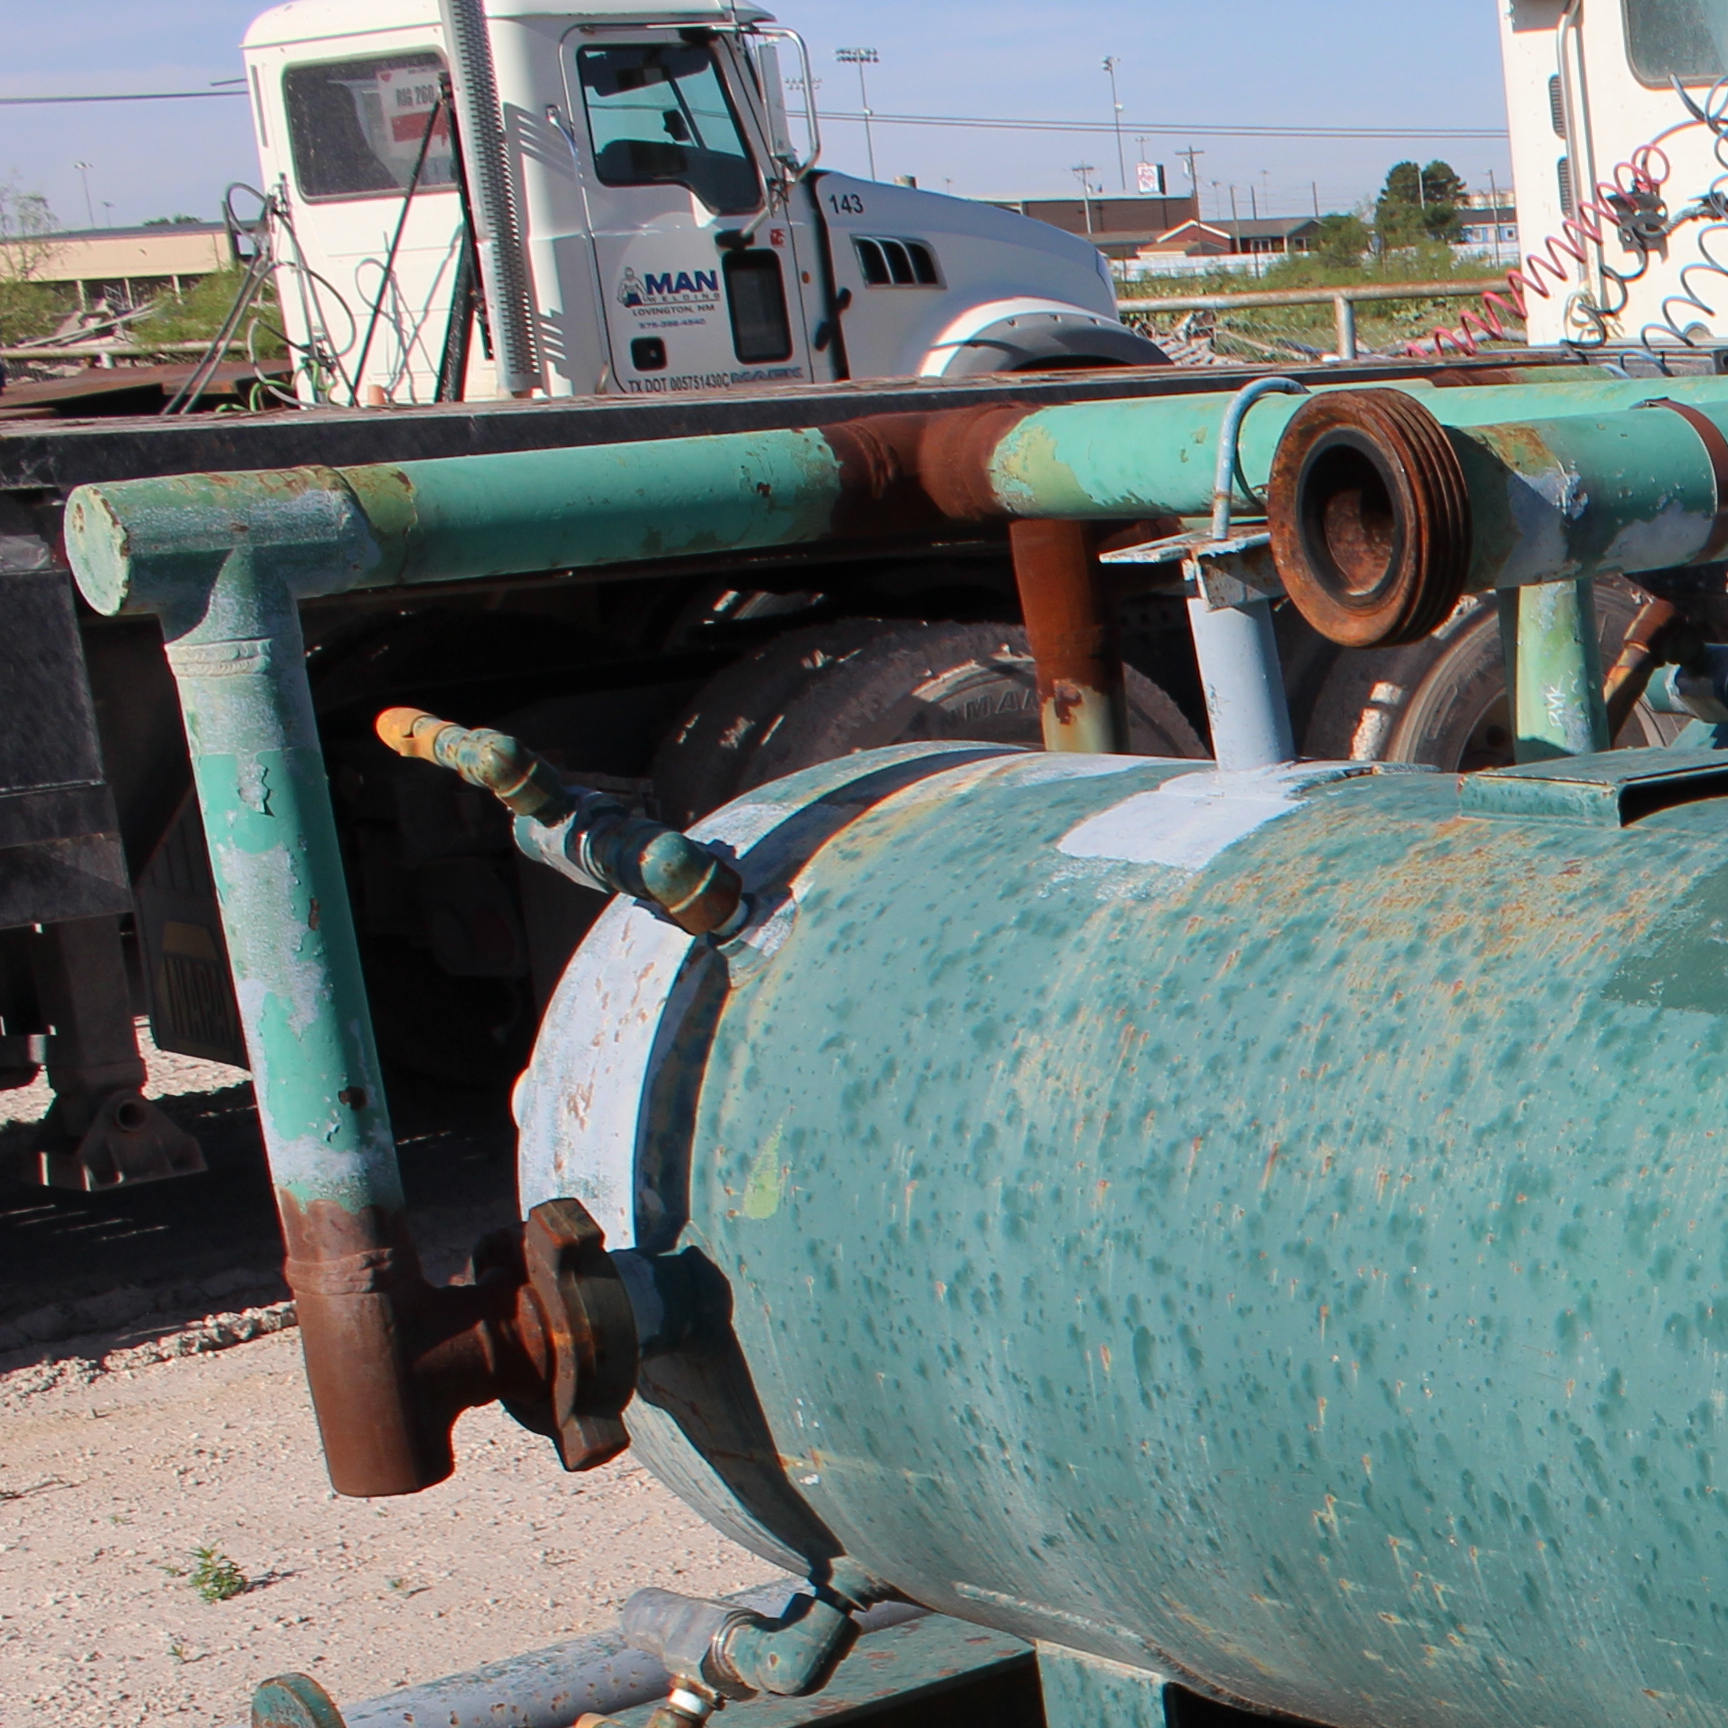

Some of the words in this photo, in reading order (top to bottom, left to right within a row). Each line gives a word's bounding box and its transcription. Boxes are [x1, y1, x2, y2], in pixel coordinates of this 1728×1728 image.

[829, 193, 865, 214] 143
[643, 269, 719, 296] MAN
[646, 292, 721, 304] WELDING
[697, 303, 716, 313] NM
[628, 379, 642, 393] TX
[645, 377, 667, 393] DOT
